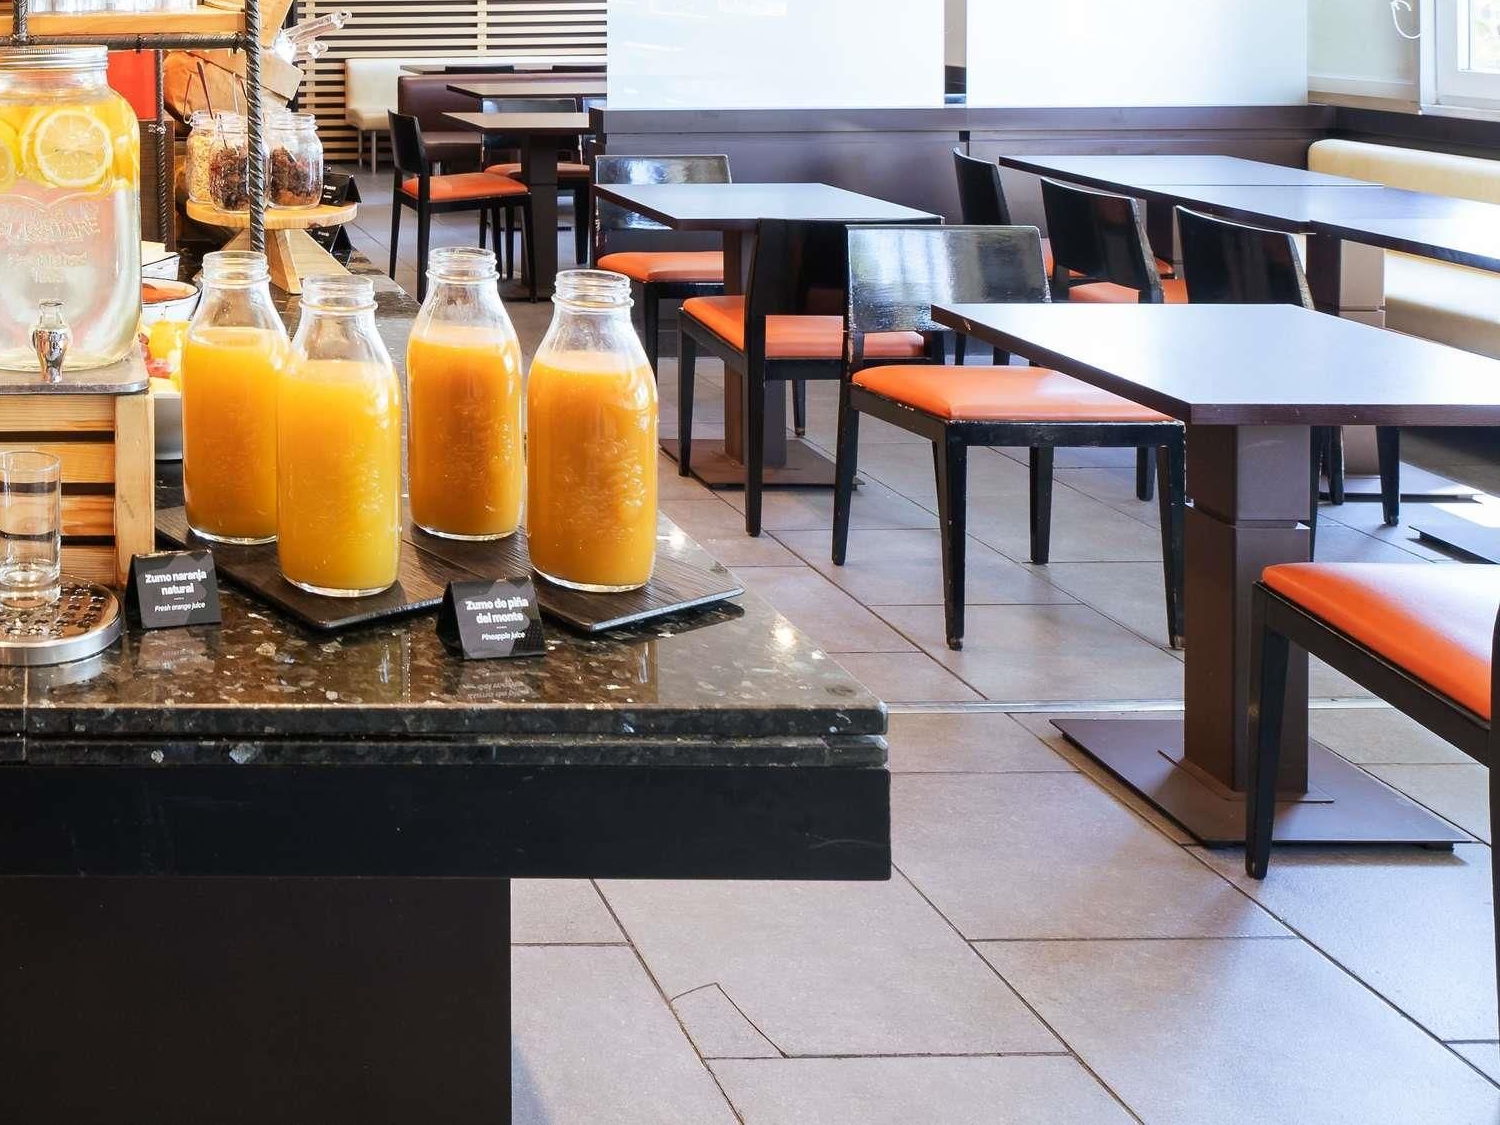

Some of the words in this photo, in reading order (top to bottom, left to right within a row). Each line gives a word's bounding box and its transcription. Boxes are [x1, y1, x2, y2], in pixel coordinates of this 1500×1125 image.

[145, 573, 172, 584] Zumo
[173, 569, 207, 582] naranja
[161, 583, 195, 595] natural
[154, 604, 171, 612] Fresh
[172, 602, 192, 611] orange
[192, 601, 206, 611] juice
[465, 600, 493, 611] Zumo
[494, 597, 507, 609] de
[508, 596, 529, 611] piña
[476, 612, 491, 624] del
[492, 611, 524, 623] monte
[481, 632, 510, 642] Pineapple
